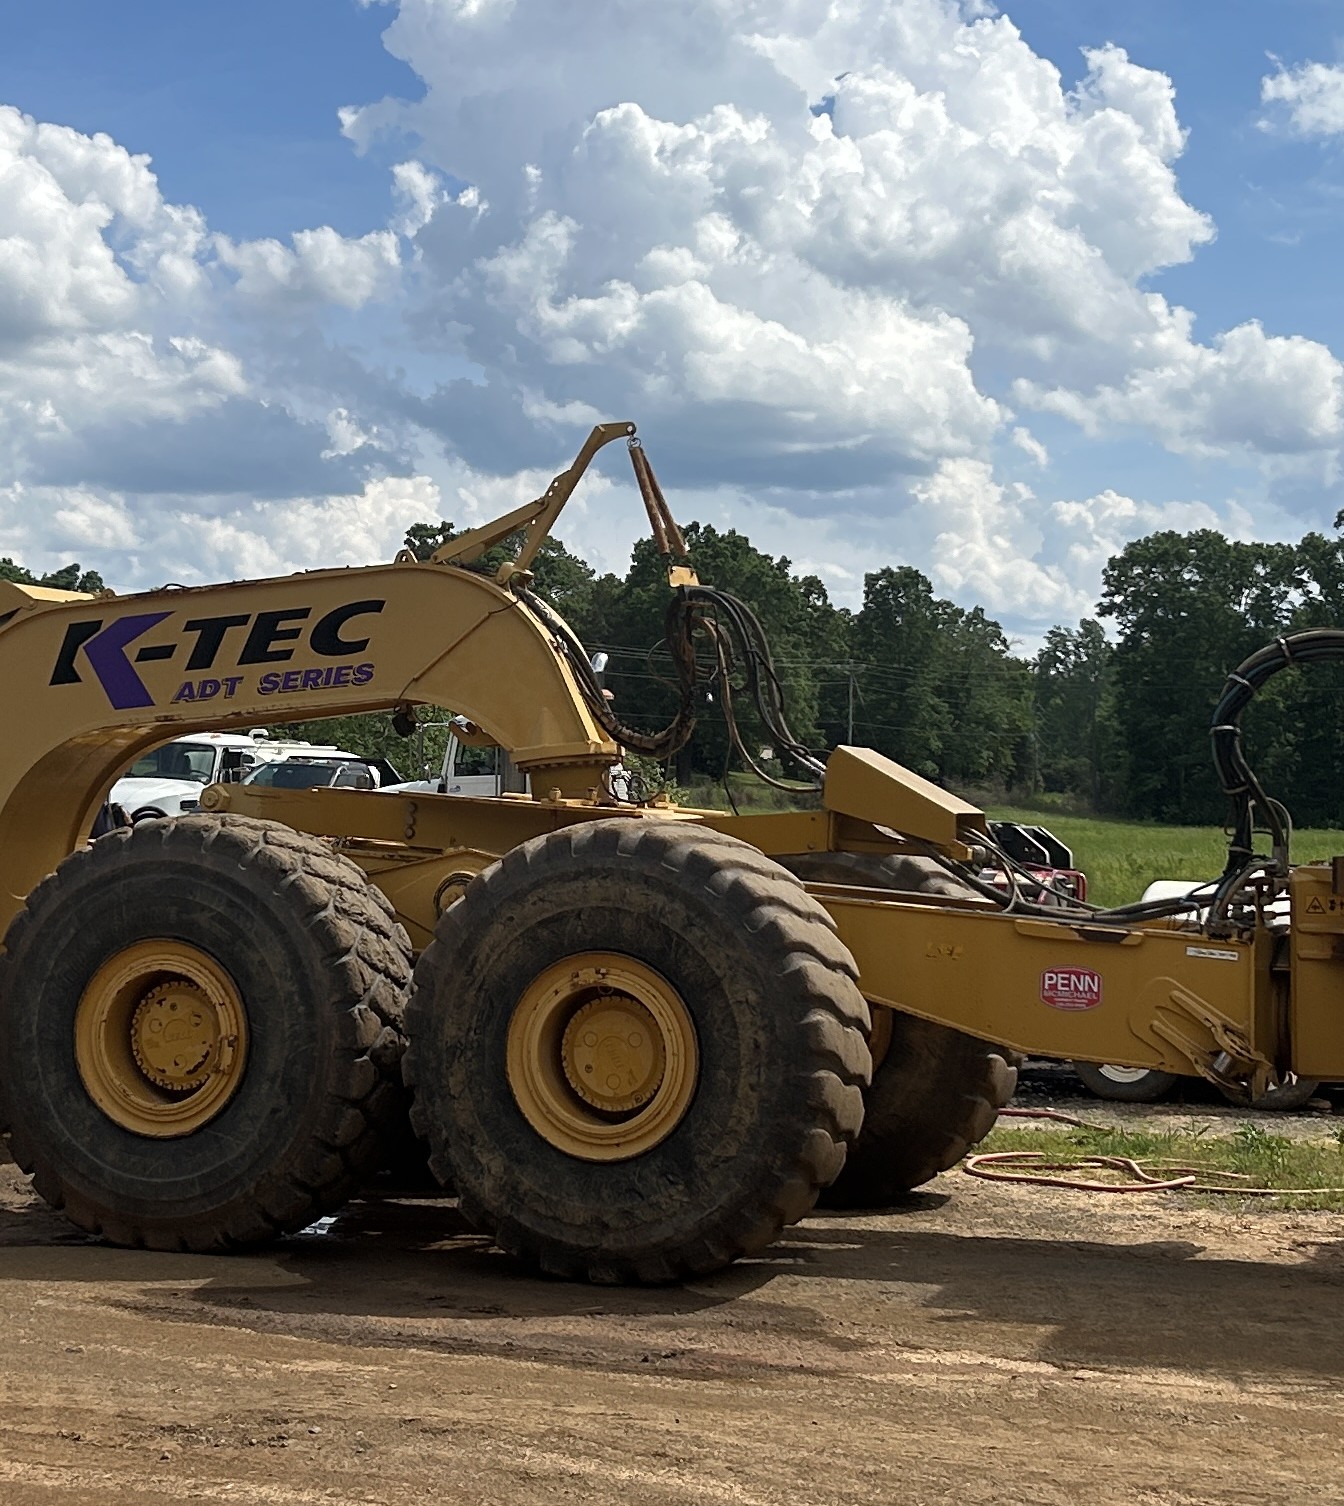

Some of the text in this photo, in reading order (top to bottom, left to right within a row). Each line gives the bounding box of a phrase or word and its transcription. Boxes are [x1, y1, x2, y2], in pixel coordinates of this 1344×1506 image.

[49, 600, 386, 710] K-TEC
[170, 663, 375, 704] ADT SERIES
[1044, 972, 1099, 993] PENN
